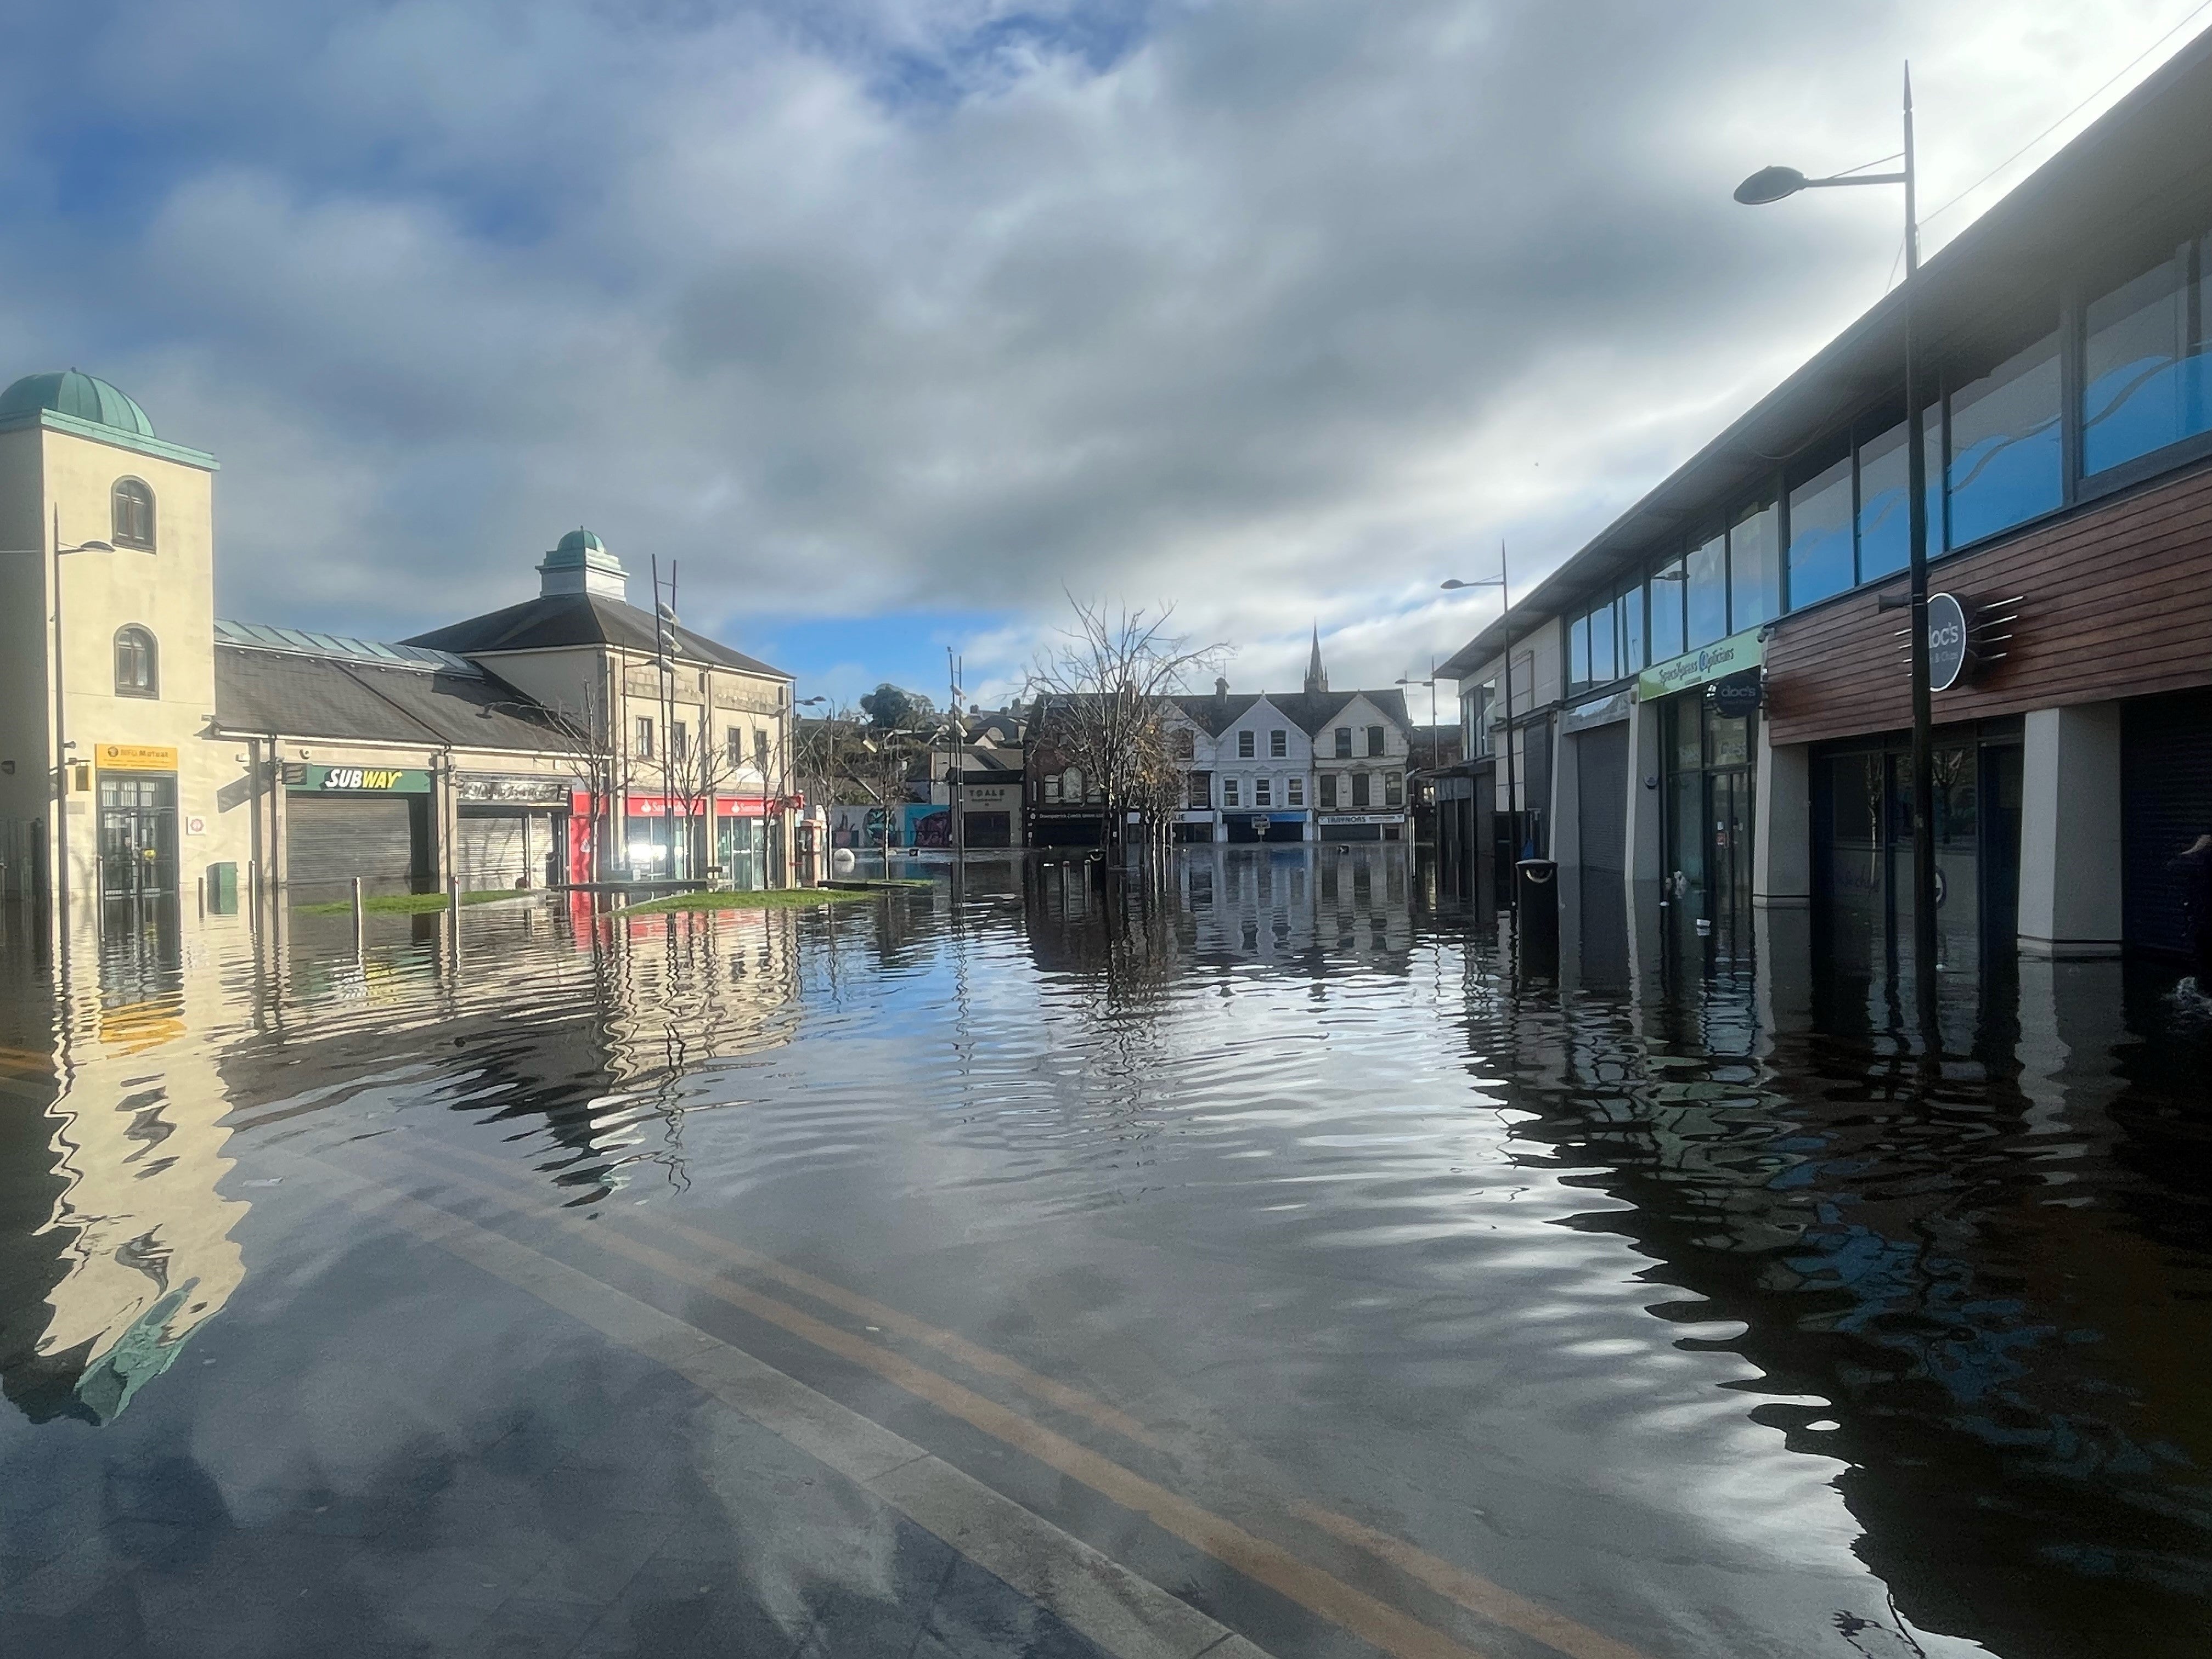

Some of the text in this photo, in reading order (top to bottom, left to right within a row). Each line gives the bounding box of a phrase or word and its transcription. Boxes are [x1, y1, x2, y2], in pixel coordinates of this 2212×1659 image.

[1928, 622, 1959, 648] oc's
[1721, 686, 1756, 697] doc's
[325, 769, 403, 789] SUBWAY
[652, 801, 687, 812] Sander
